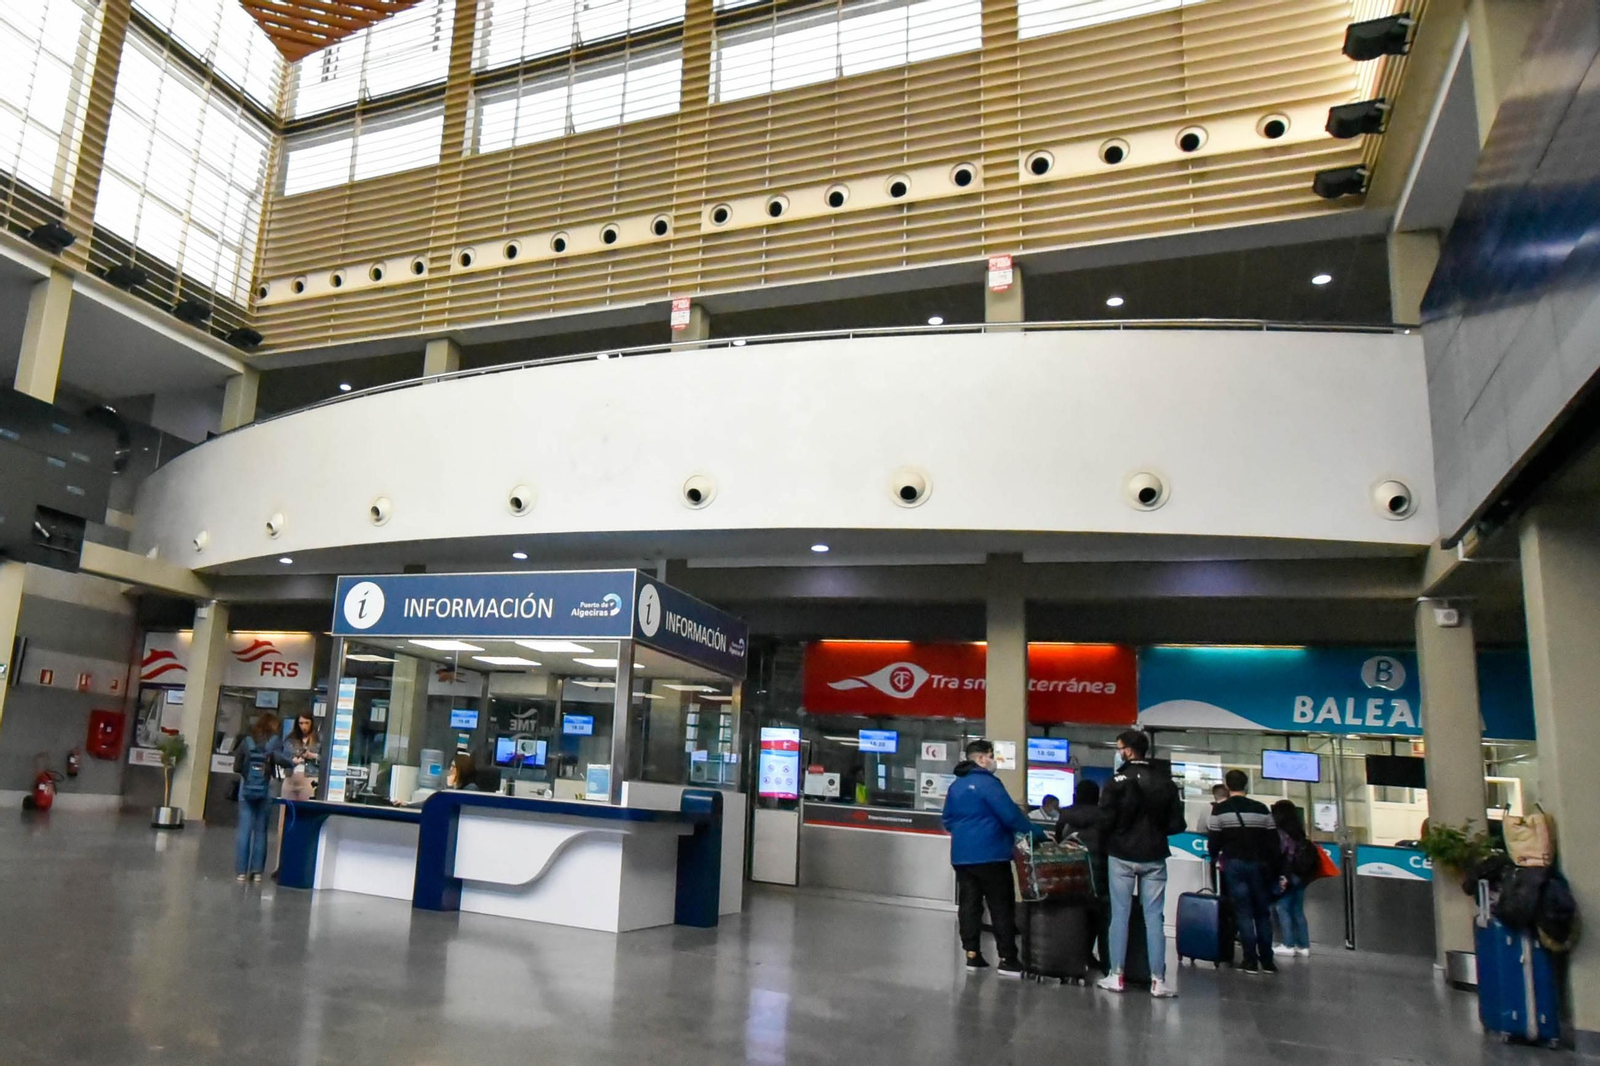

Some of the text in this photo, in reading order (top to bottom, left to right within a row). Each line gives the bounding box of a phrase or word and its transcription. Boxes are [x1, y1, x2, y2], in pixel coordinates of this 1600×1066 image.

[403, 593, 553, 618] INFORMACIÓN
[571, 608, 609, 618] Algeciras
[665, 610, 727, 653] INFORMACIÓN
[260, 661, 299, 678] FRS
[1374, 659, 1394, 683] B
[1293, 695, 1486, 730] BALEA
